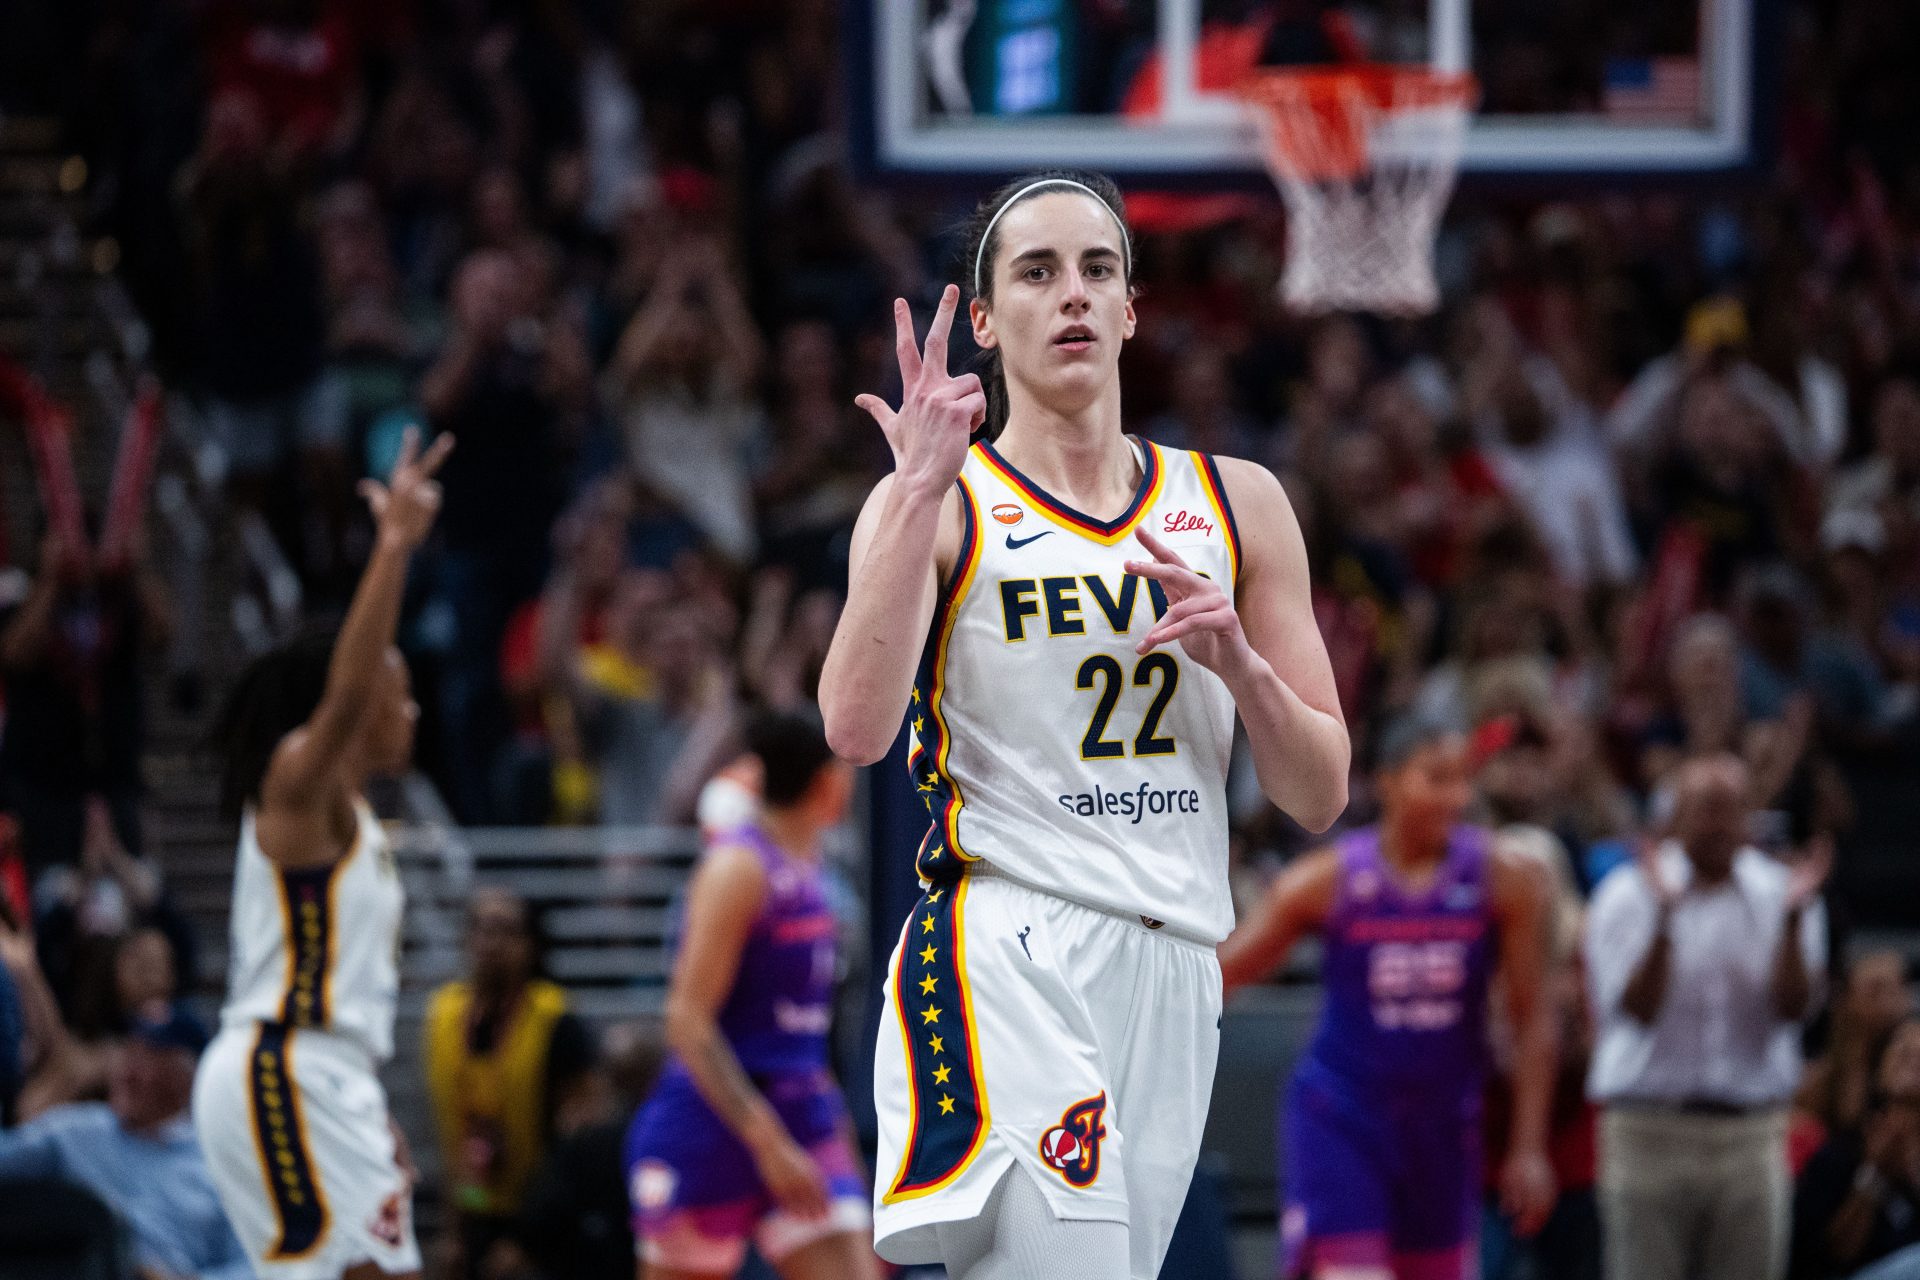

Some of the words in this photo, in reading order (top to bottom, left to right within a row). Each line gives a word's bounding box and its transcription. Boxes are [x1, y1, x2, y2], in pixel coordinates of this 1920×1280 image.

[1164, 510, 1213, 537] Lilly
[999, 571, 1212, 643] FEV
[1075, 651, 1181, 761] 22
[1058, 782, 1199, 824] salesforce
